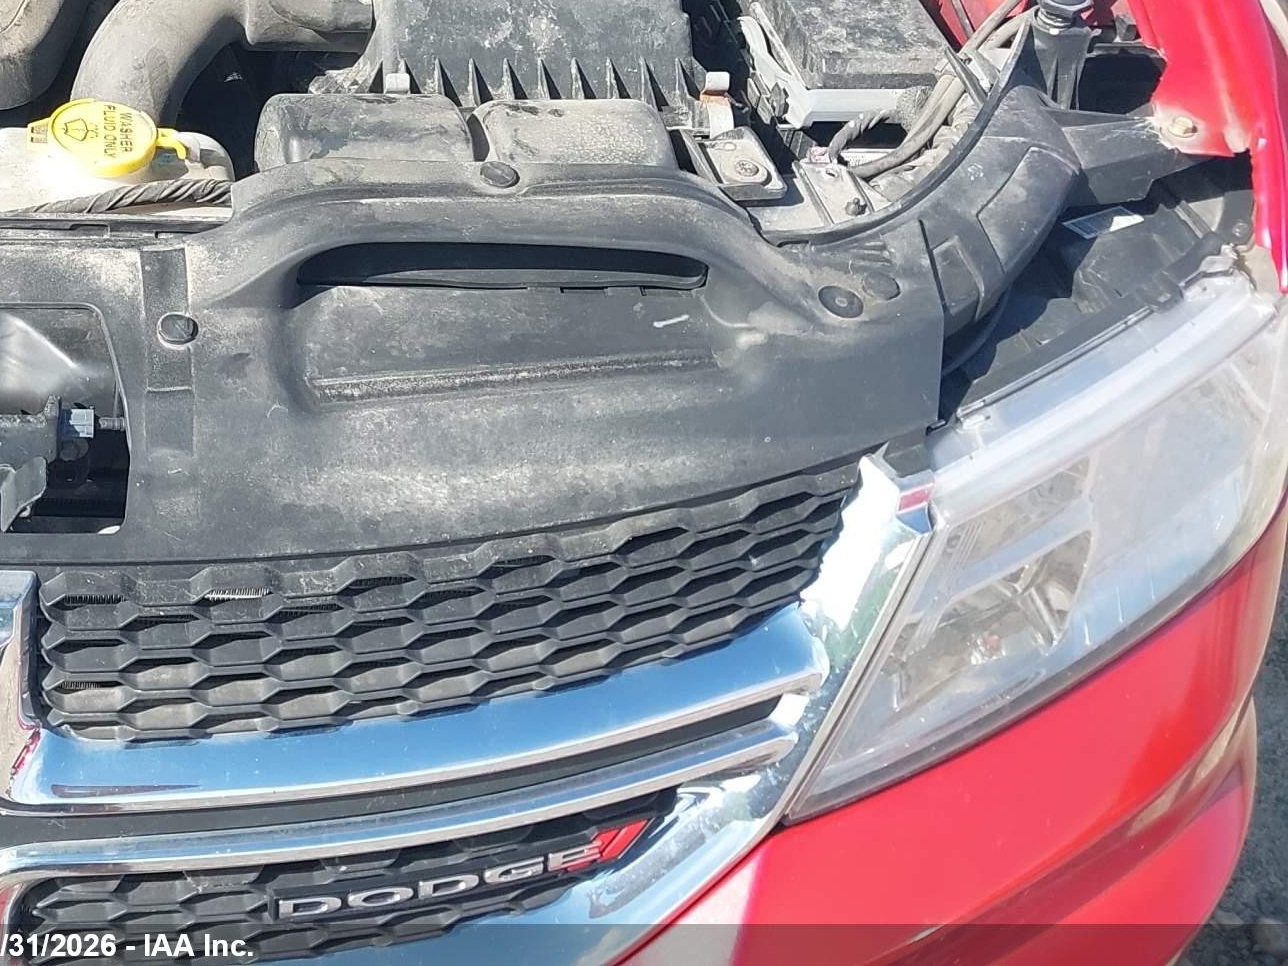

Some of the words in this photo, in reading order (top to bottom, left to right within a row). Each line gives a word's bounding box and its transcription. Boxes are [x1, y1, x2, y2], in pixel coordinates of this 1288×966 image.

[103, 105, 117, 132] FLUID
[119, 112, 133, 153] WASHER
[103, 133, 117, 159] ONLY
[278, 840, 601, 920] DODGE
